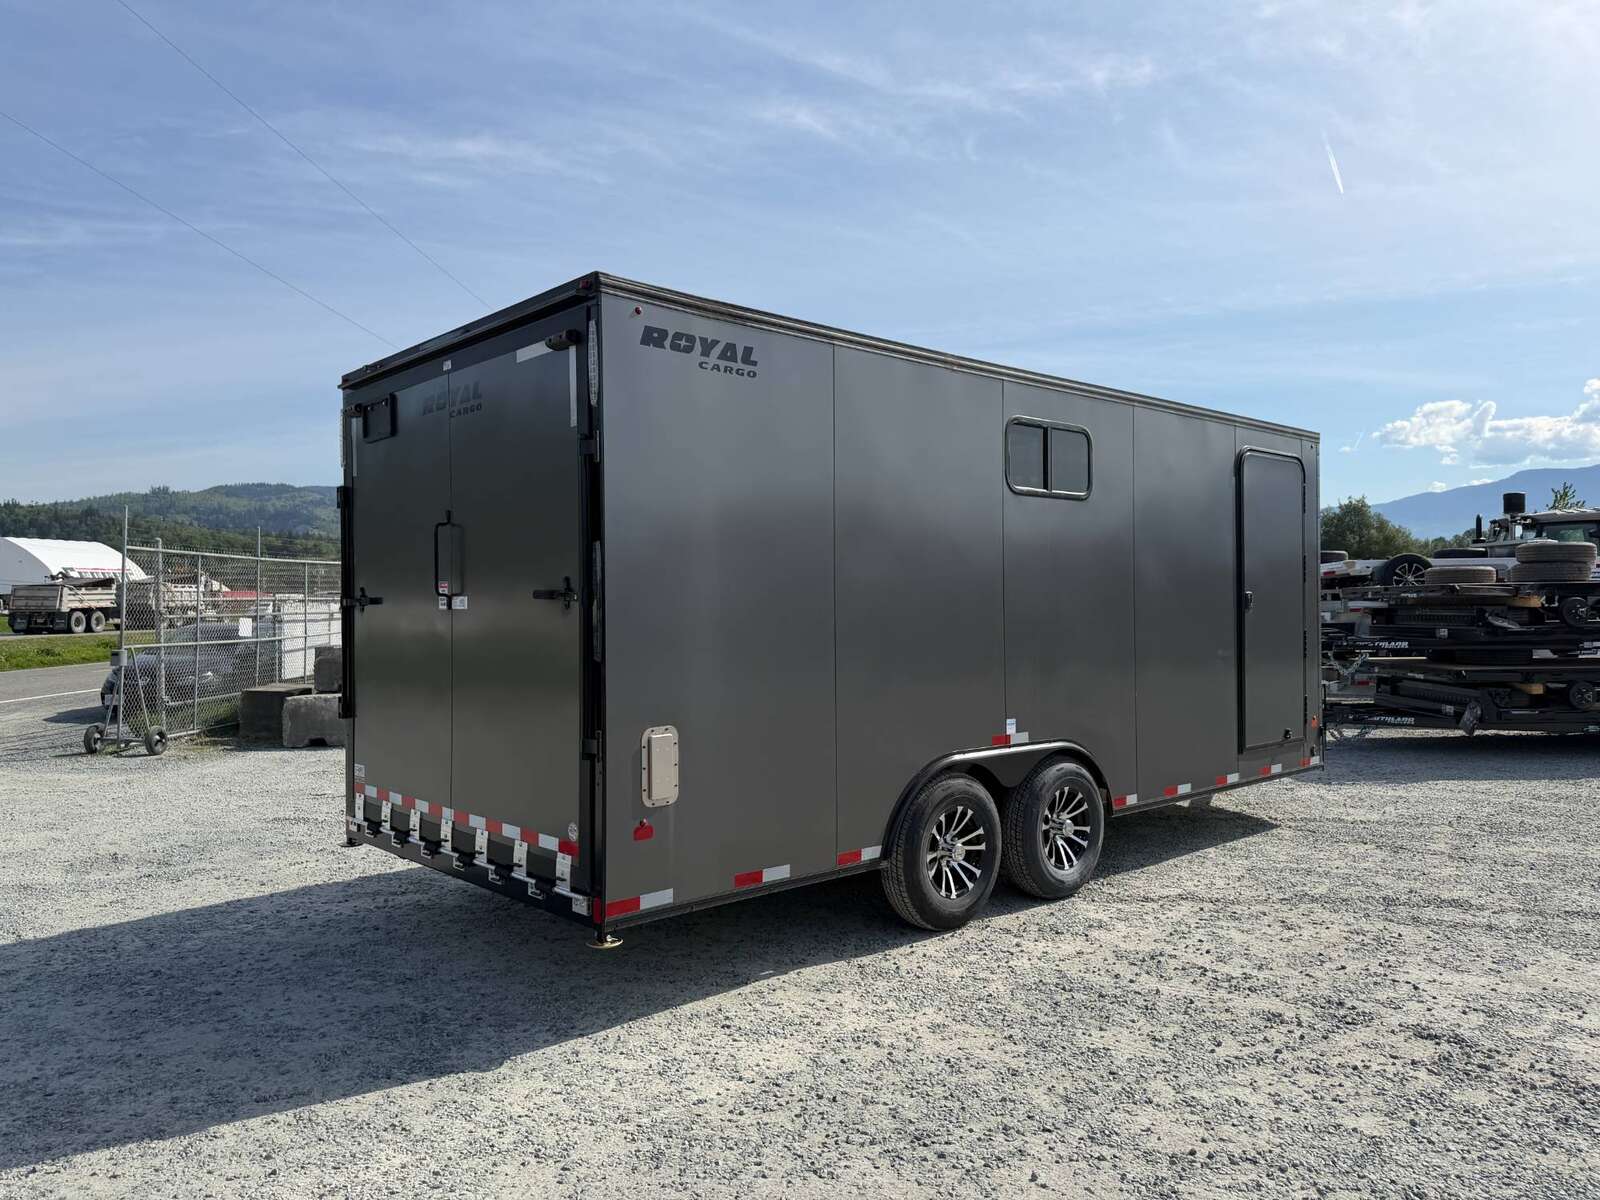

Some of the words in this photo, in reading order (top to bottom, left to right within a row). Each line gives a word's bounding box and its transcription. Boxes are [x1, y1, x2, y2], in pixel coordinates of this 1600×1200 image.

[640, 325, 758, 367] ROYAL
[698, 361, 758, 378] CARGO
[422, 381, 482, 416] ROYAL
[449, 403, 482, 418] CARGO
